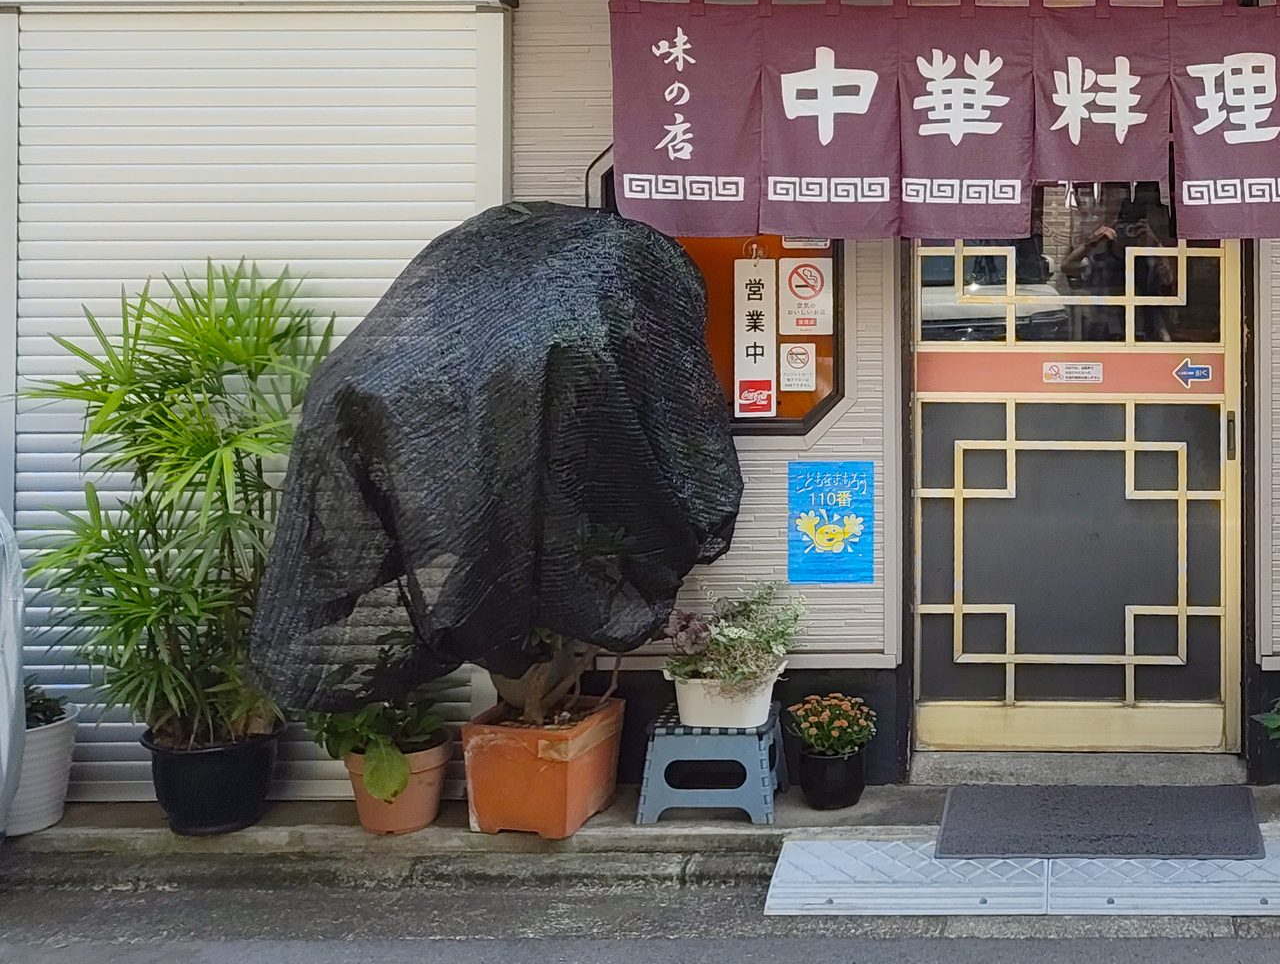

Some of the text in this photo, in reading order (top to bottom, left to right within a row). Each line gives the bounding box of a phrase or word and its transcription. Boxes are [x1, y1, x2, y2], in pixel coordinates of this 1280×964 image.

[651, 26, 697, 161] 味の店
[745, 278, 765, 364] 営業中
[809, 490, 853, 508] 110番
